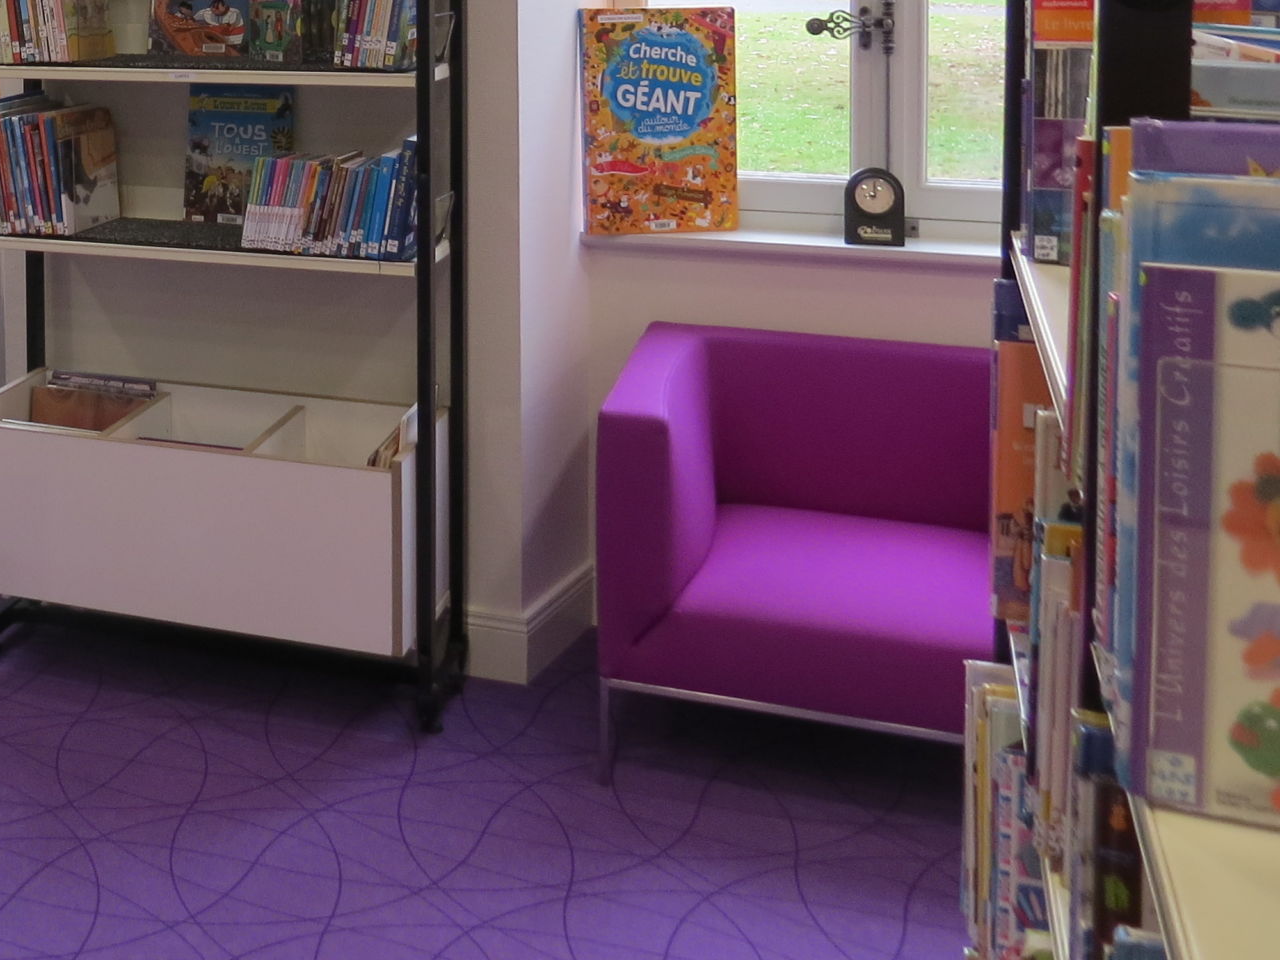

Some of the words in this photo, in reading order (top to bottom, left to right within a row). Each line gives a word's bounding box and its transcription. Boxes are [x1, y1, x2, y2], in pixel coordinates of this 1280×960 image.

[629, 42, 697, 67] Cherche
[616, 61, 640, 80] et
[641, 59, 703, 86] trouve
[616, 80, 702, 115] GÉANT
[211, 122, 268, 140] TOUS
[637, 121, 653, 133] du
[655, 121, 691, 133] monde
[643, 115, 682, 125] autour
[1159, 421, 1192, 517] Loisirs
[1155, 529, 1186, 577] des
[1154, 588, 1185, 722] L'Univers
